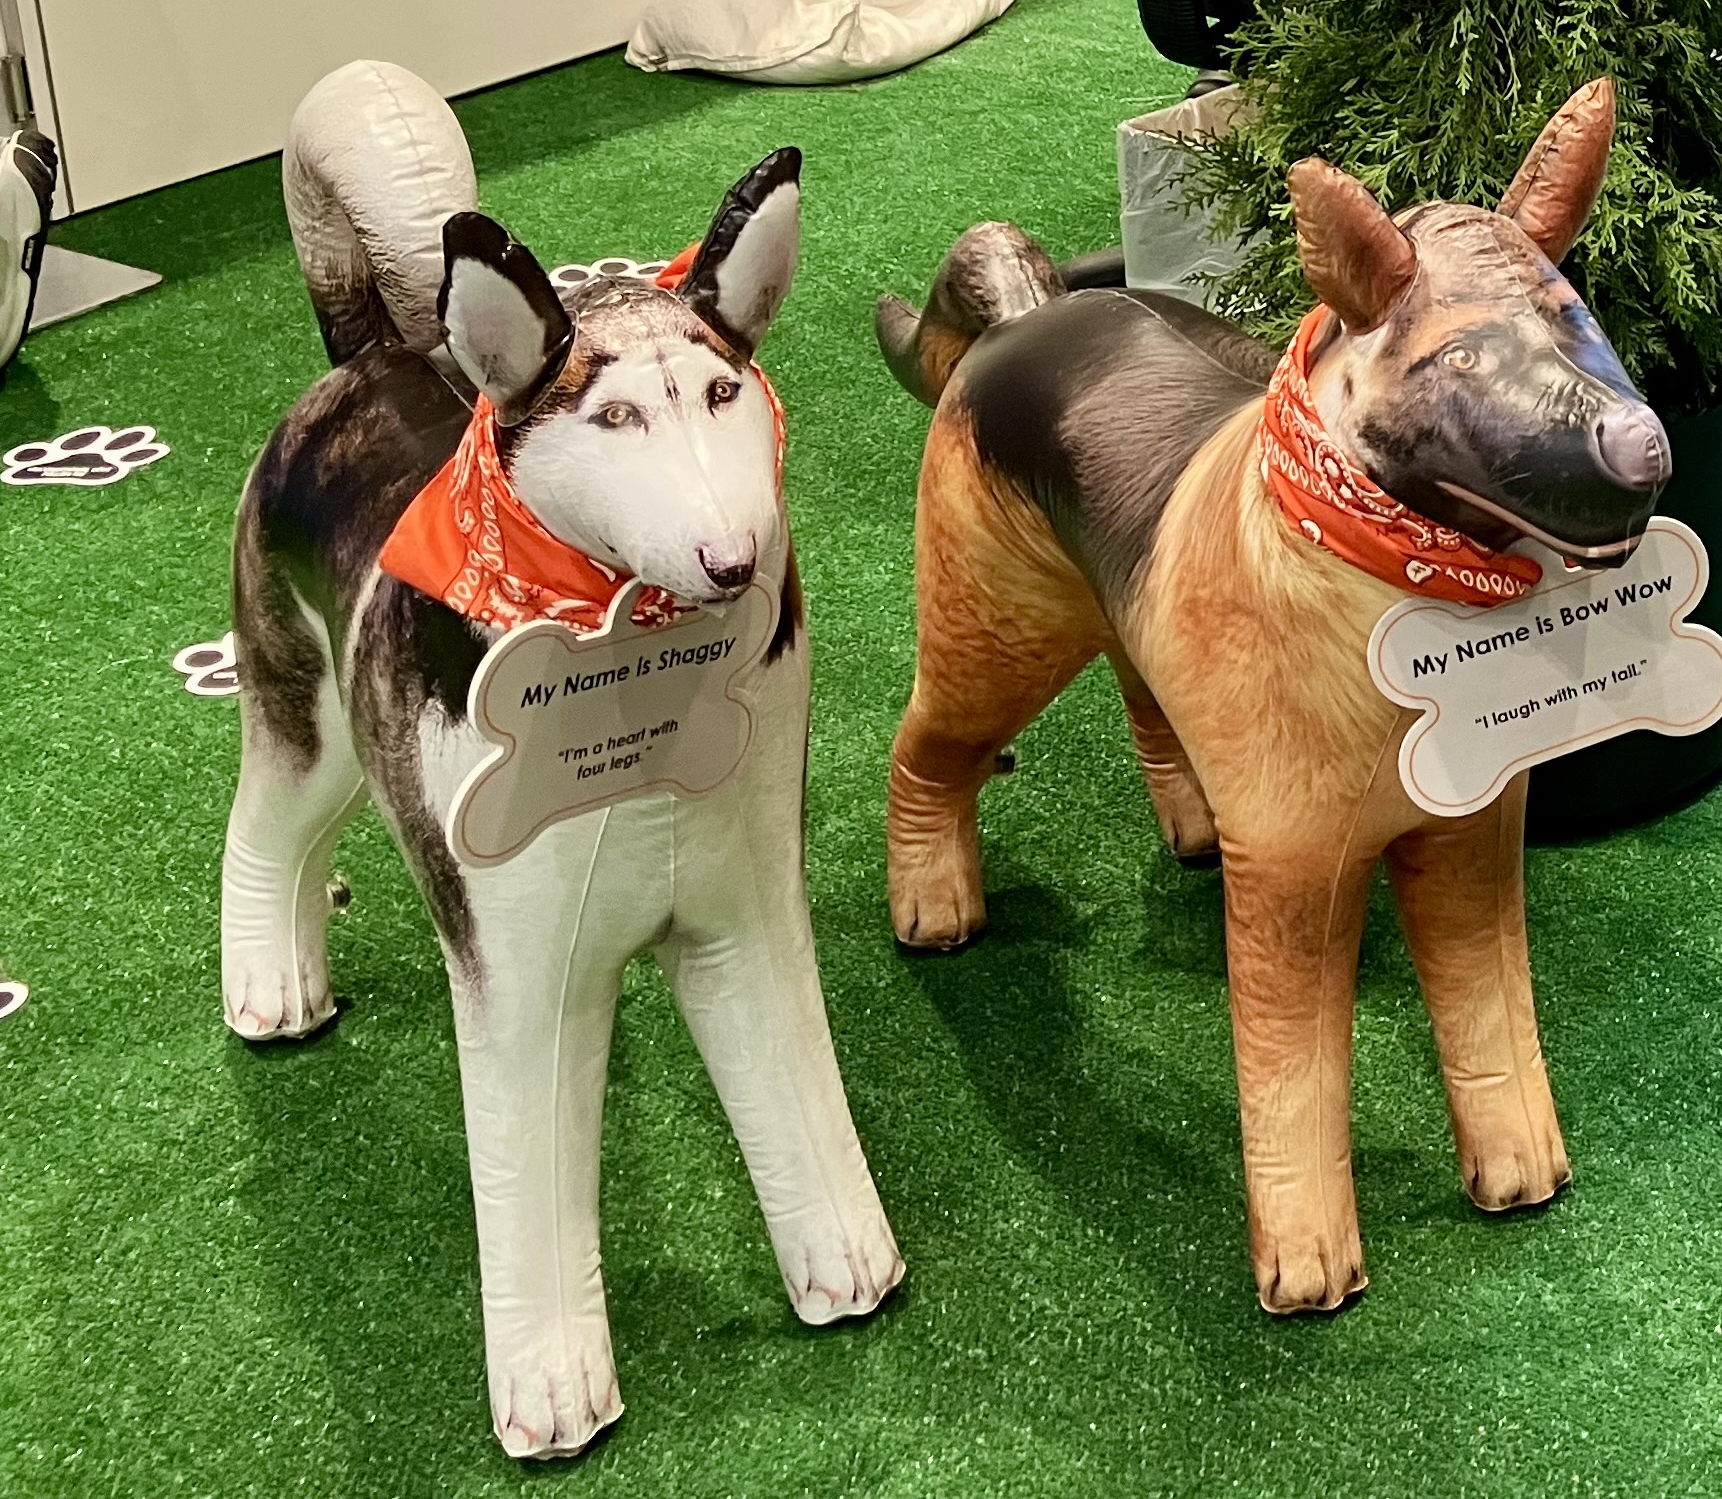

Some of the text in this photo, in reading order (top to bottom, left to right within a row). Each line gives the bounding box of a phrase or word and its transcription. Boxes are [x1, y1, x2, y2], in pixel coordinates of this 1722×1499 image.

[1412, 574, 1673, 678] My Name is Bow Wow
[520, 683, 558, 709] My
[562, 665, 631, 697] Name
[656, 636, 737, 673] Shaggy
[1491, 698, 1541, 727] laugh
[1544, 685, 1578, 707] with
[1581, 676, 1608, 696] my
[591, 741, 604, 756] a
[605, 730, 646, 752] heart
[649, 718, 680, 740] with
[576, 761, 607, 781] four
